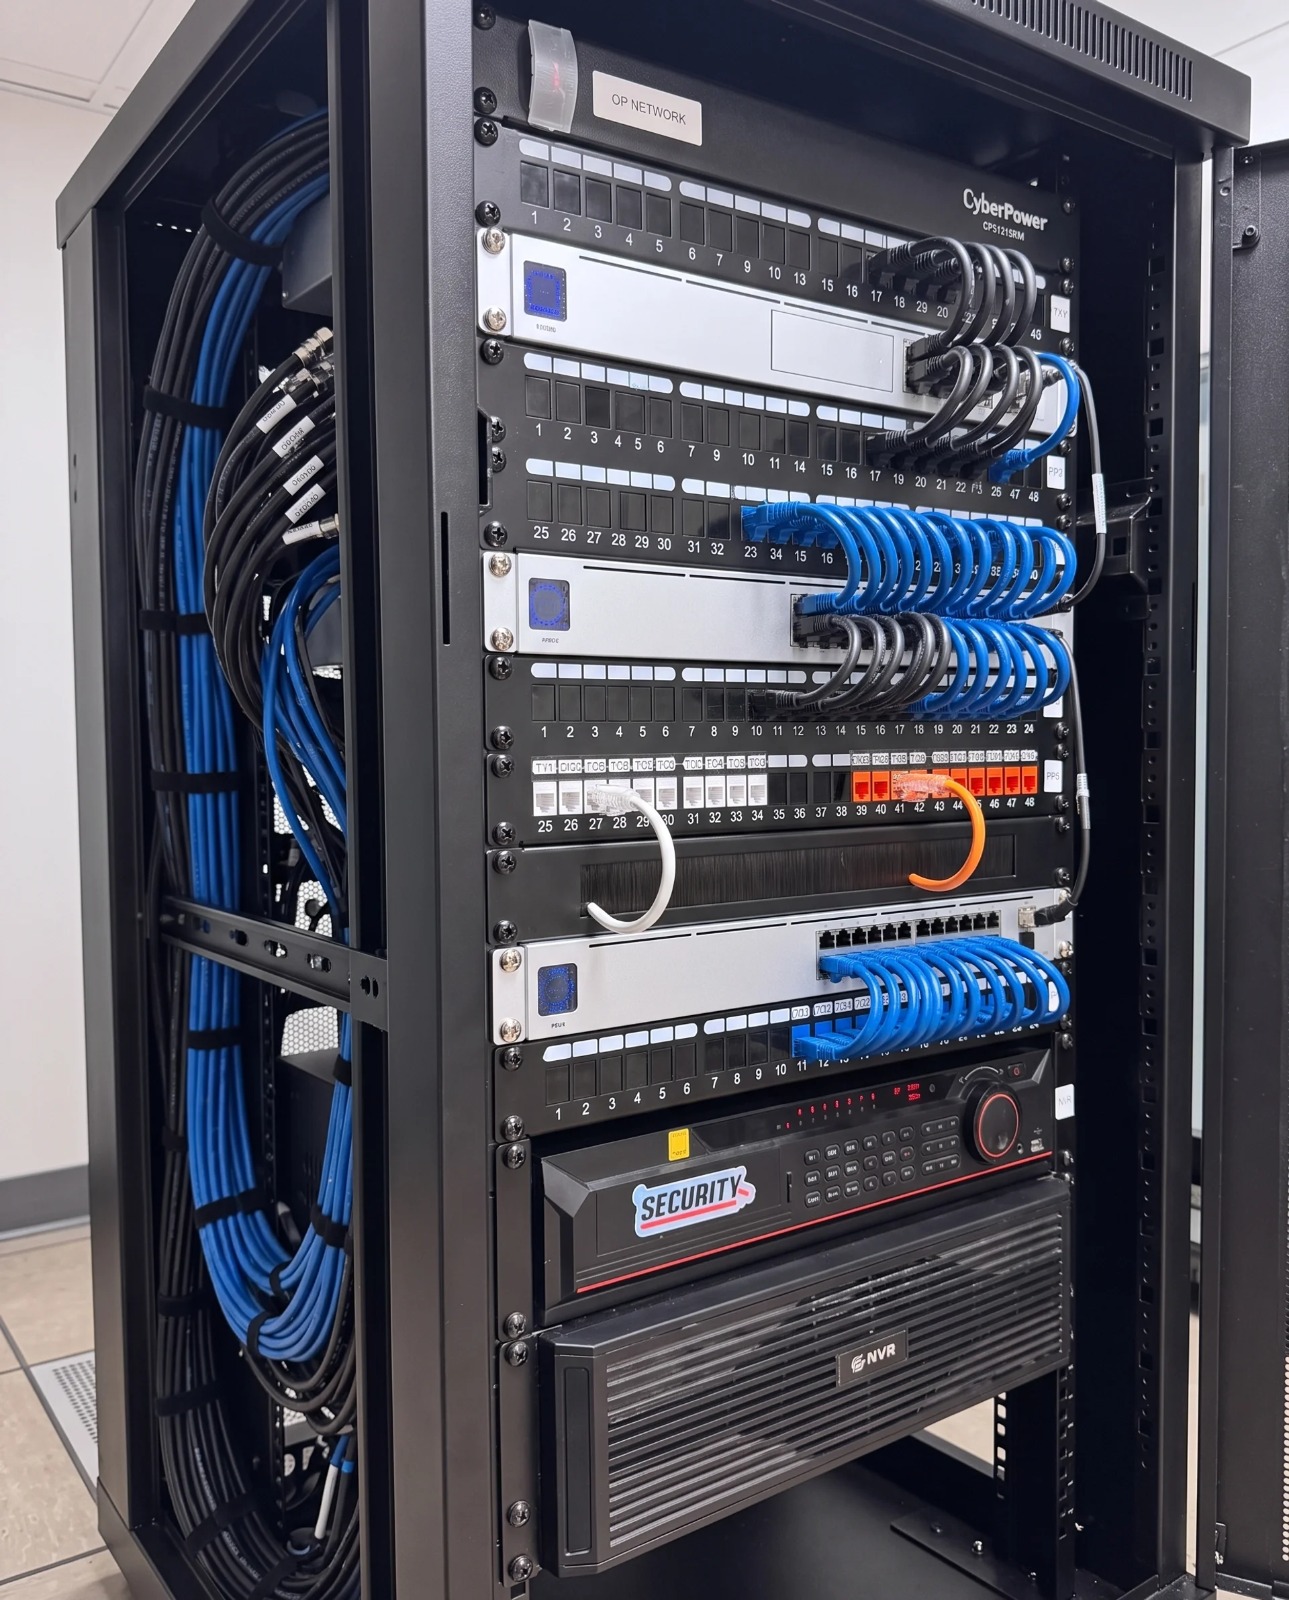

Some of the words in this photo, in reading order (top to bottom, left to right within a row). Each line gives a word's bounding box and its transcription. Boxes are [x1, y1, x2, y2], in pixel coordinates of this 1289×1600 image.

[612, 94, 628, 106] OP
[632, 99, 685, 124] NETWORK
[963, 189, 1047, 230] CyberPower
[532, 211, 536, 224] 1
[564, 218, 571, 231] 2
[595, 225, 601, 238] 3
[626, 233, 632, 246] 4
[656, 239, 663, 252] 5
[689, 248, 695, 260] 6
[717, 254, 723, 266] 7
[745, 261, 750, 273] 9
[769, 266, 780, 279] 10
[794, 272, 806, 285] 13
[822, 278, 833, 291] 15
[847, 285, 858, 297] 16
[872, 290, 882, 302] 17
[895, 296, 905, 308] 18
[917, 301, 927, 313] 29
[937, 306, 948, 318] 20
[536, 423, 541, 436] 1
[564, 427, 571, 440] 2
[591, 431, 597, 443] 3
[615, 435, 621, 447] 4
[635, 438, 641, 450] 5
[658, 441, 664, 453] 6
[689, 445, 695, 457] 7
[714, 449, 720, 461] 9
[743, 453, 754, 465] 10
[770, 457, 779, 469] 11
[795, 461, 805, 472] 14
[822, 464, 832, 475] 15
[846, 467, 857, 479] 16
[870, 470, 880, 481] 17
[894, 474, 904, 484] 19
[916, 476, 926, 487] 20
[937, 479, 946, 490] 21
[956, 482, 966, 492] 22
[991, 486, 1001, 497] 26
[1010, 489, 1020, 499] 47
[1029, 492, 1038, 502] 48
[534, 526, 549, 539] 25
[561, 528, 576, 541] 26
[587, 531, 601, 543] 27
[612, 533, 626, 546] 28
[635, 535, 649, 548] 29
[658, 538, 671, 550] 30
[688, 540, 699, 553] 31
[711, 543, 724, 555] 32
[745, 546, 757, 557] 23
[771, 548, 782, 560] 34
[795, 551, 806, 562] 15
[822, 553, 833, 564] 16
[542, 726, 546, 737] 1
[567, 726, 574, 737] 2
[592, 726, 598, 737] 3
[616, 726, 622, 737] 4
[640, 726, 646, 737] 5
[663, 726, 669, 737] 6
[689, 726, 695, 736] 7
[711, 726, 717, 736] 8
[733, 726, 738, 736] 9
[752, 726, 762, 735] 10
[773, 726, 782, 735] 11
[793, 726, 803, 735] 12
[816, 725, 826, 735] 13
[836, 726, 846, 735] 14
[856, 725, 866, 735] 15
[876, 725, 885, 734] 16
[895, 725, 904, 734] 17
[914, 725, 924, 734] 18
[934, 725, 943, 734] 19
[953, 725, 962, 734] 20
[971, 724, 979, 733] 21
[989, 724, 998, 733] 22
[1007, 724, 1016, 733] 23
[1024, 724, 1033, 733] 24
[538, 820, 552, 832] 25
[564, 819, 578, 831] 26
[589, 818, 603, 829] 27
[613, 817, 626, 828] 28
[637, 816, 649, 827] 29
[688, 813, 698, 824] 31
[709, 812, 721, 823] 32
[731, 811, 742, 822] 33
[752, 810, 763, 820] 34
[774, 809, 785, 819] 35
[794, 808, 805, 818] 36
[816, 807, 826, 817] 37
[837, 806, 847, 816] 38
[857, 805, 867, 815] 39
[876, 804, 886, 814] 40
[895, 804, 904, 813] 41
[913, 801, 924, 812] 42
[935, 801, 944, 811] 43
[953, 800, 963, 810] 44
[990, 799, 999, 808] 46
[1007, 798, 1016, 807] 47
[1025, 797, 1034, 806] 48
[556, 1108, 560, 1120] 1
[583, 1103, 589, 1115] 2
[609, 1098, 615, 1109] 3
[634, 1092, 641, 1103] 4
[659, 1087, 665, 1099] 5
[684, 1083, 690, 1094] 6
[712, 1077, 718, 1088] 7
[734, 1073, 740, 1084] 8
[756, 1069, 761, 1080] 9
[776, 1064, 786, 1075] 10
[797, 1060, 807, 1071] 11
[641, 1175, 741, 1221] SECURITY
[867, 1344, 895, 1364] NVR
